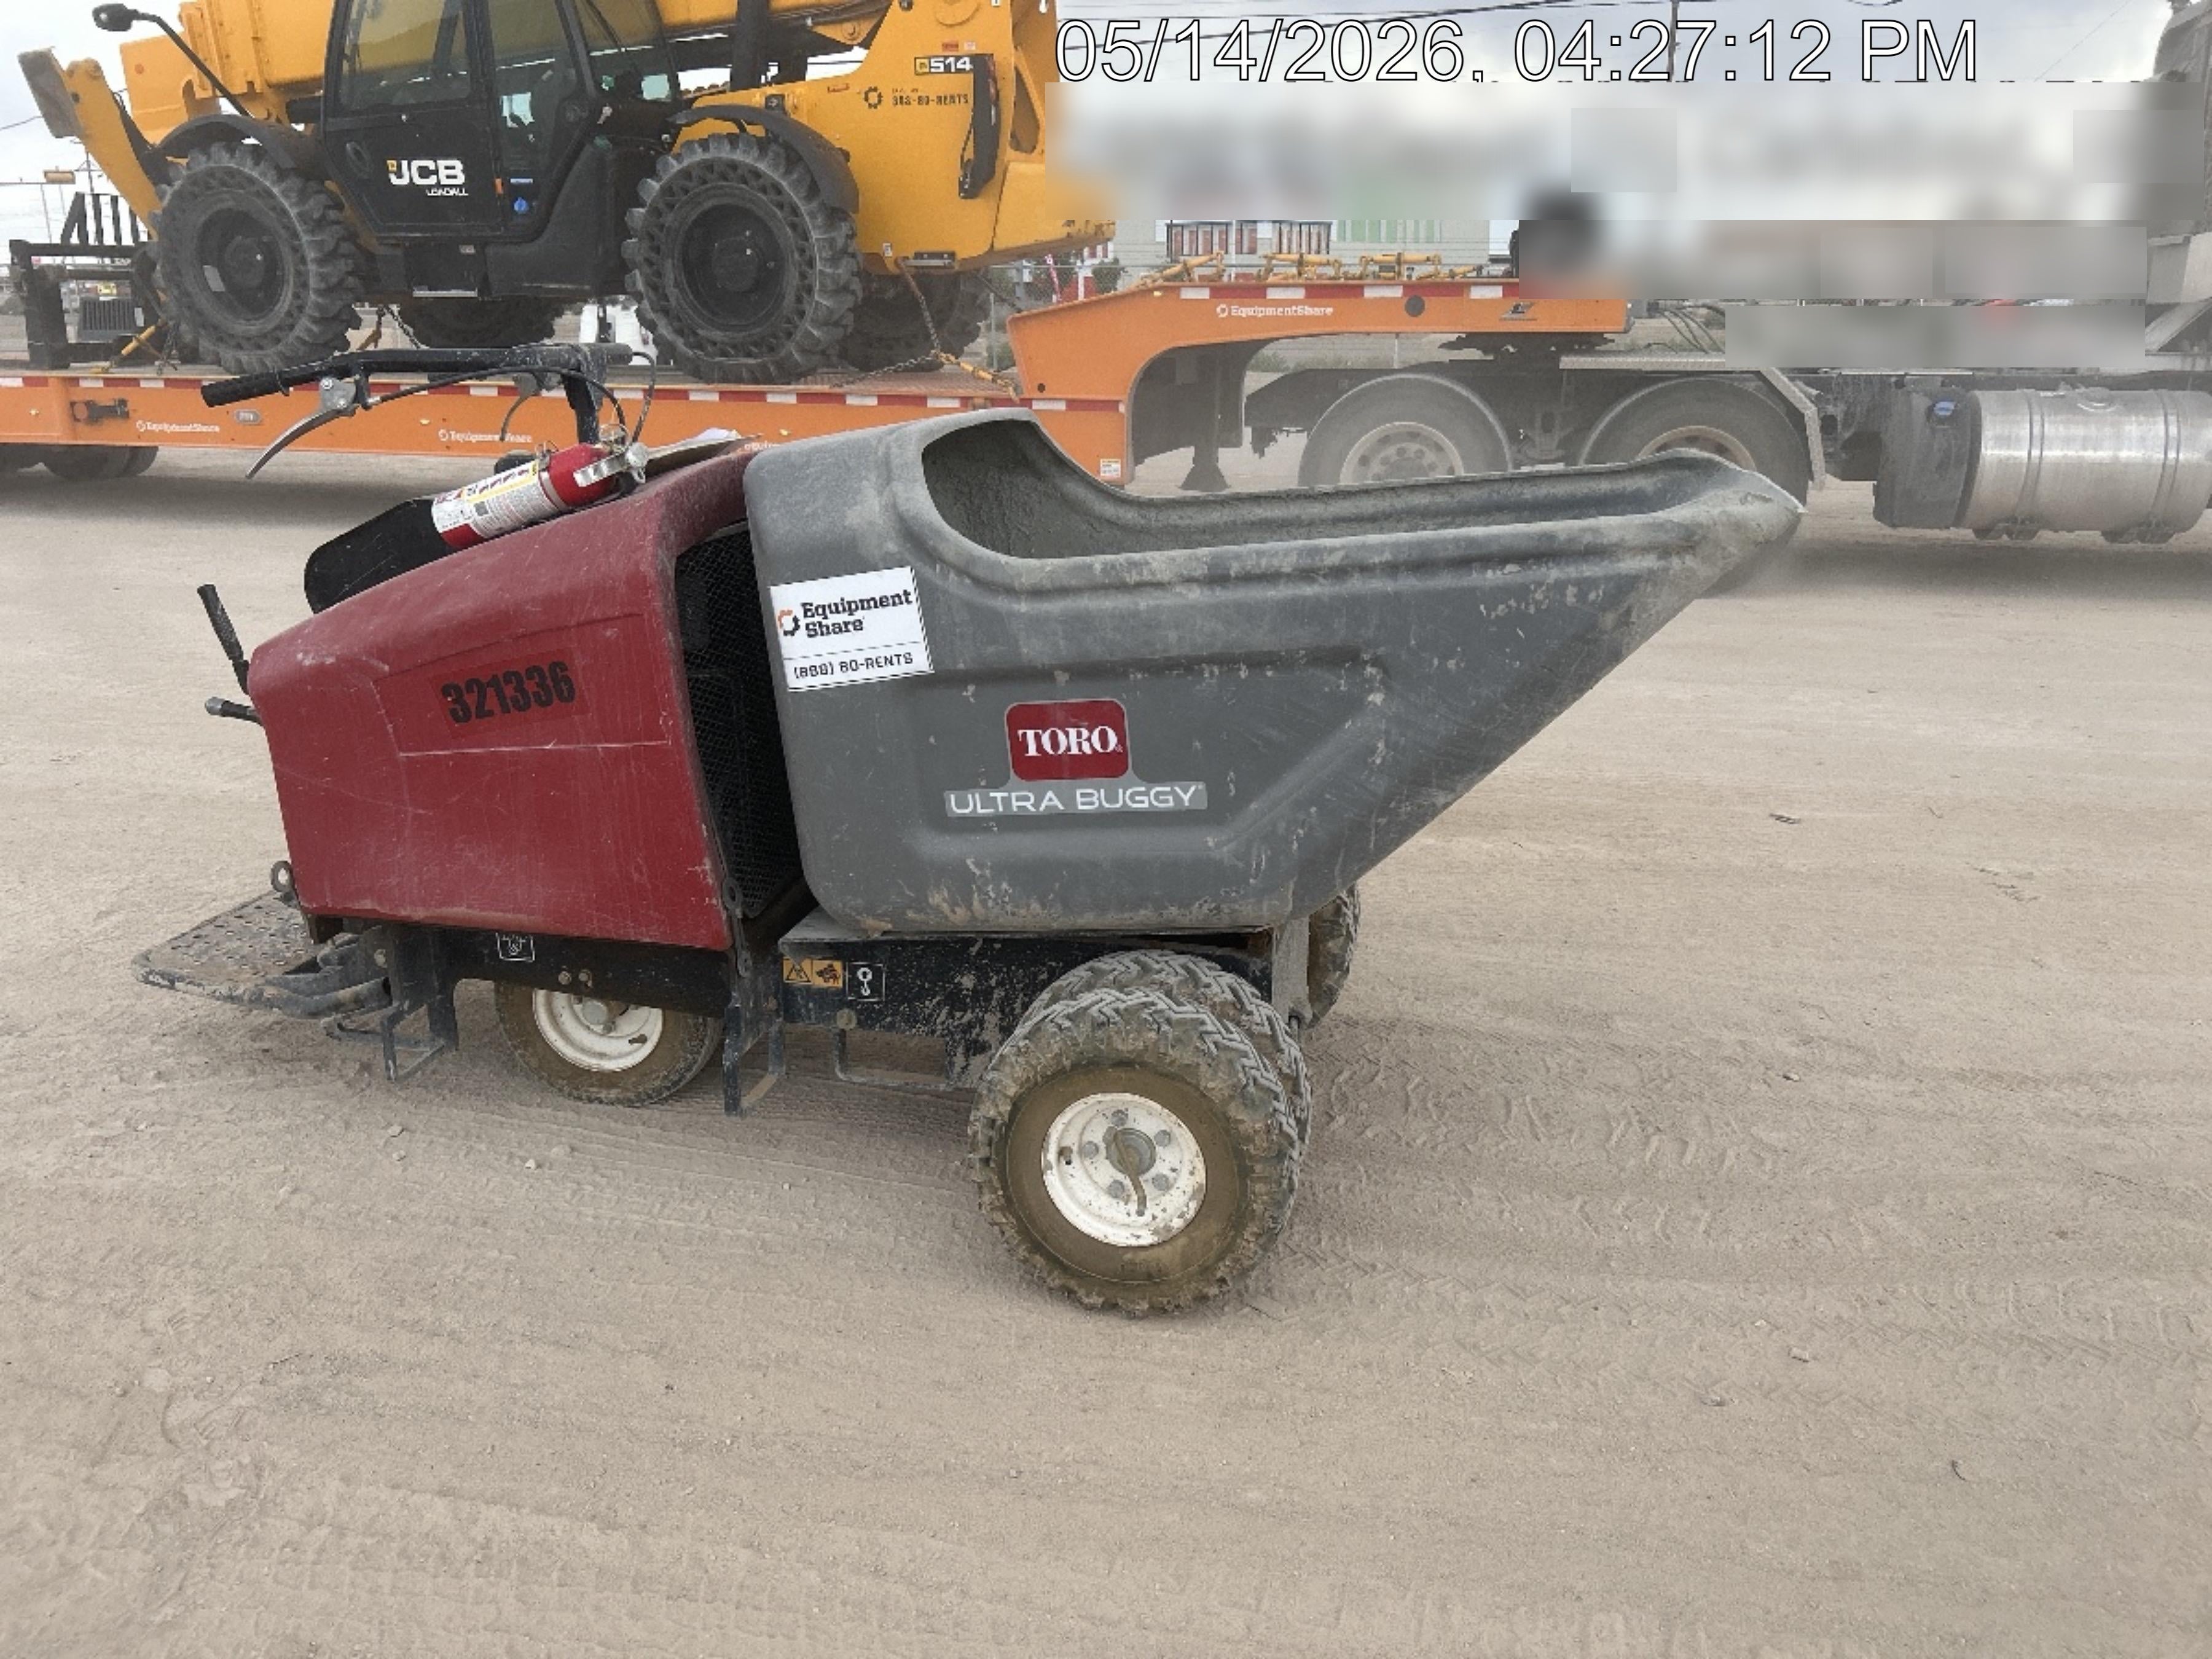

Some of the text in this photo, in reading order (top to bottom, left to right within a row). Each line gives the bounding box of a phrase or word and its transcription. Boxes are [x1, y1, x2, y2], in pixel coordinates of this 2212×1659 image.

[930, 57, 972, 73] 514
[386, 160, 465, 185] JCB
[801, 589, 913, 620] Equipment
[805, 618, 864, 638] Share
[441, 661, 576, 723] 321336
[1018, 726, 1119, 756] TORO
[951, 785, 1196, 814] ULTRA BUGGY
